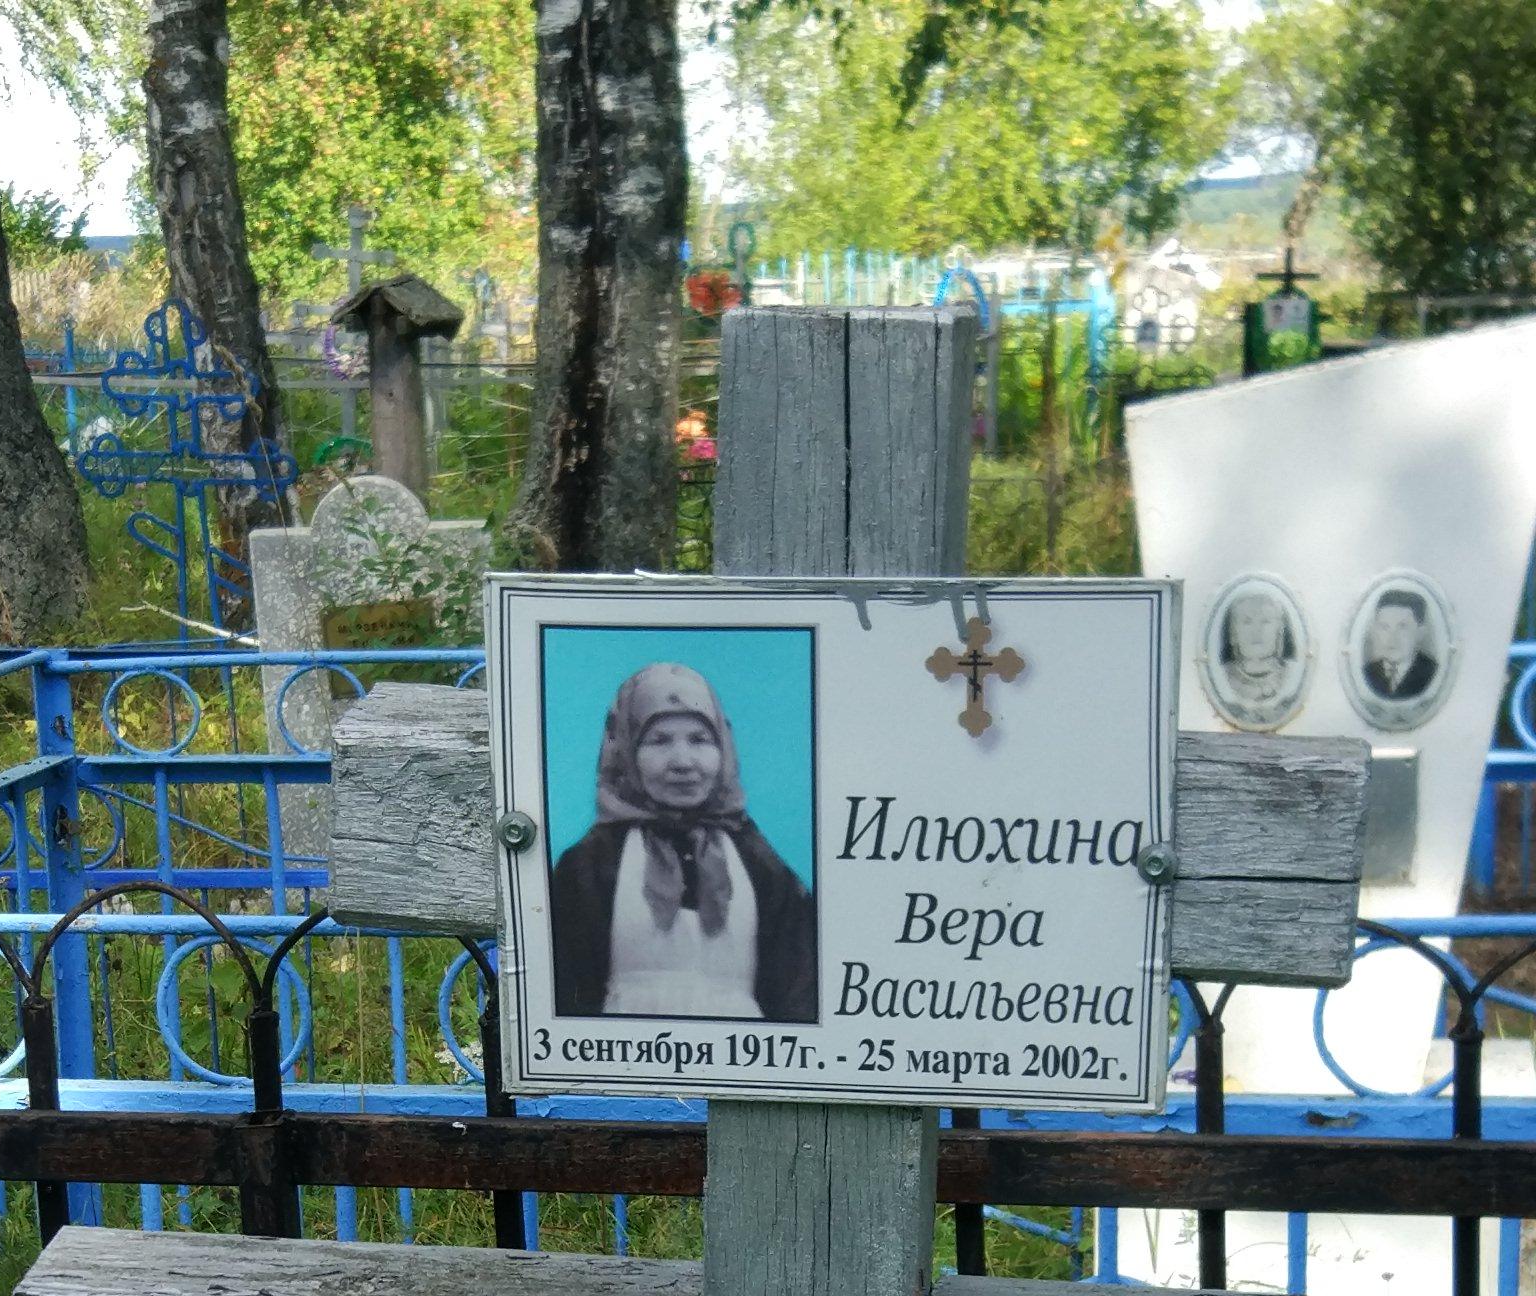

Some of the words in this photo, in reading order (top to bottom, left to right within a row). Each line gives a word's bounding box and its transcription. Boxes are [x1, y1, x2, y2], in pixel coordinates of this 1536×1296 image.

[835, 795, 1145, 867] Илюхина
[894, 891, 1045, 961] Вера
[833, 961, 1135, 1026] Васильевна
[533, 1027, 552, 1061] 3
[561, 1030, 715, 1074] сентября
[725, 1033, 826, 1070] 1917г.
[857, 1038, 896, 1072] 25
[905, 1048, 1011, 1084] марта
[1021, 1043, 1128, 1082] 2002г.
